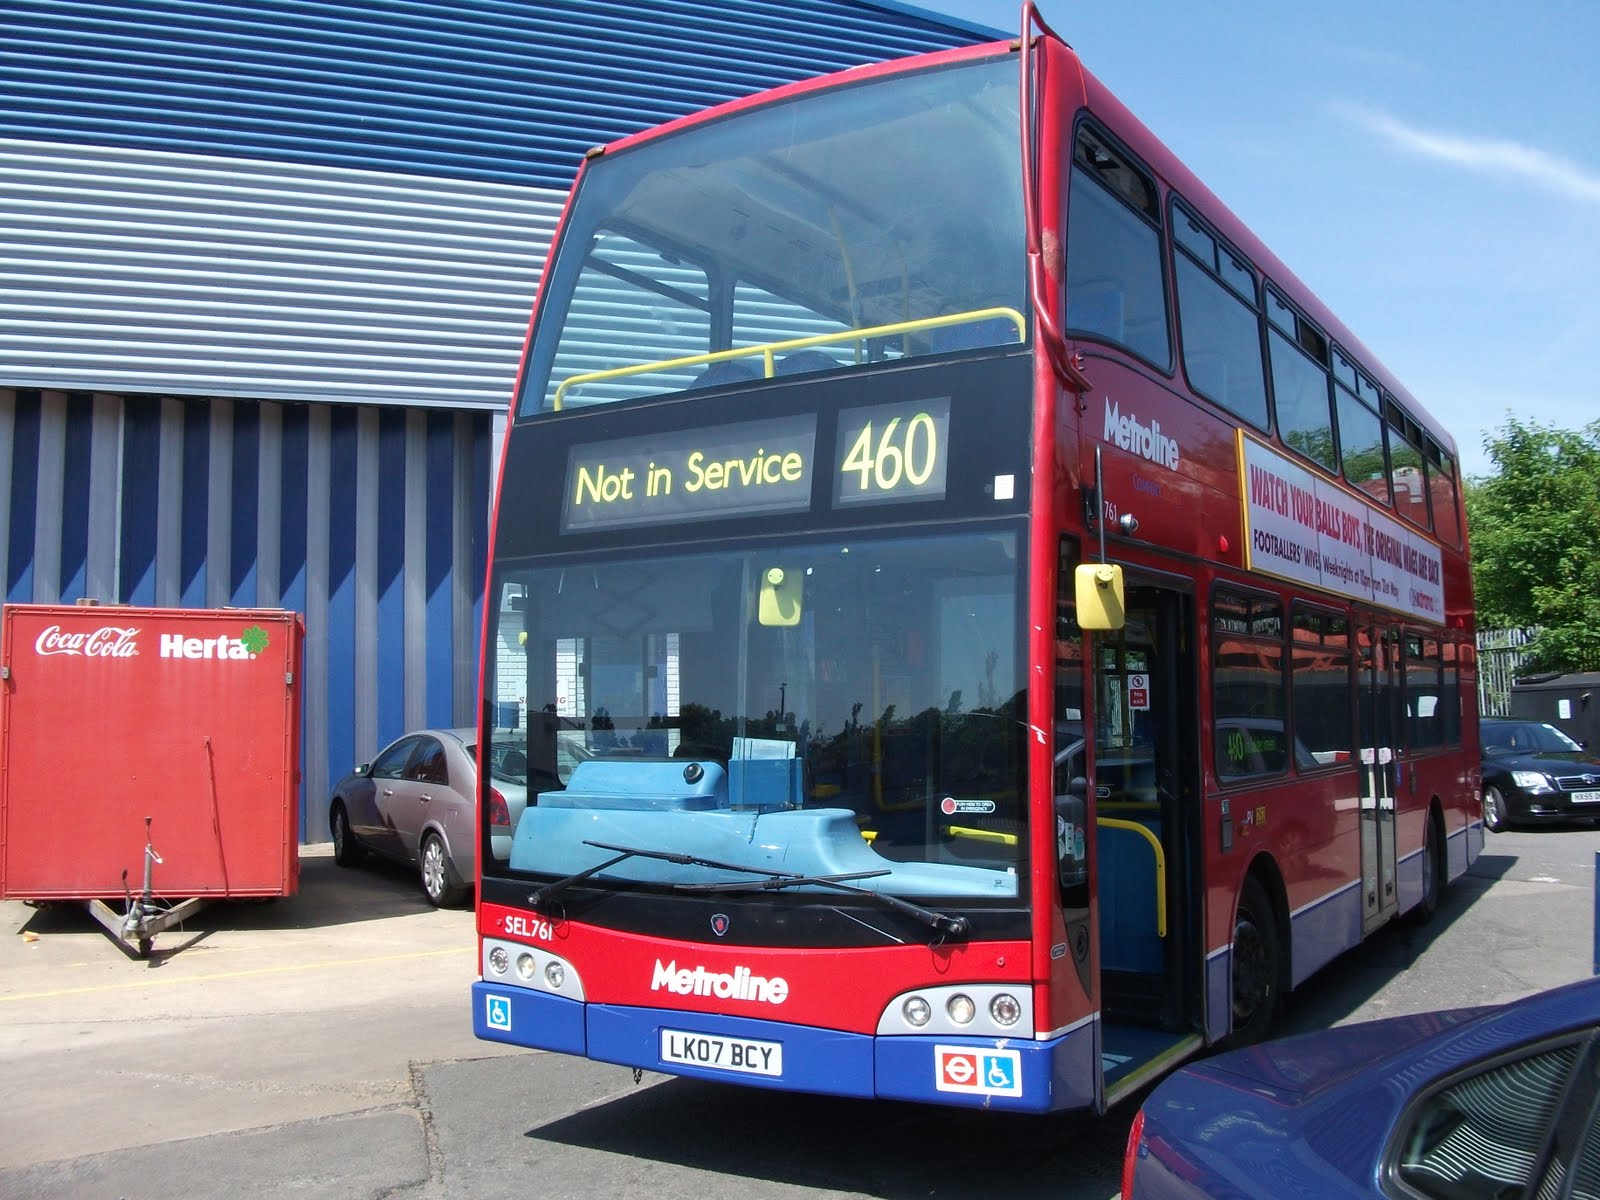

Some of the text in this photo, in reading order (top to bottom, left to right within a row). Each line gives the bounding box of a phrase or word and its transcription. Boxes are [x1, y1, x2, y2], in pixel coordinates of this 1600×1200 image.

[841, 412, 937, 491] 460
[1103, 394, 1180, 472] Metroline
[575, 447, 803, 505] Not in Service
[1104, 500, 1117, 522] 761
[1250, 463, 1289, 518] WATCH
[1290, 483, 1315, 531] YOUR
[1315, 496, 1341, 542] BALLS
[1363, 522, 1375, 557] THE
[1376, 529, 1403, 570] ORIGINAL
[1322, 554, 1354, 585] Weeknights
[35, 625, 142, 658] Coca-Cola
[504, 915, 553, 941] SEL761
[651, 958, 789, 1005] Metroline
[670, 1034, 772, 1070] LK07 BCY
